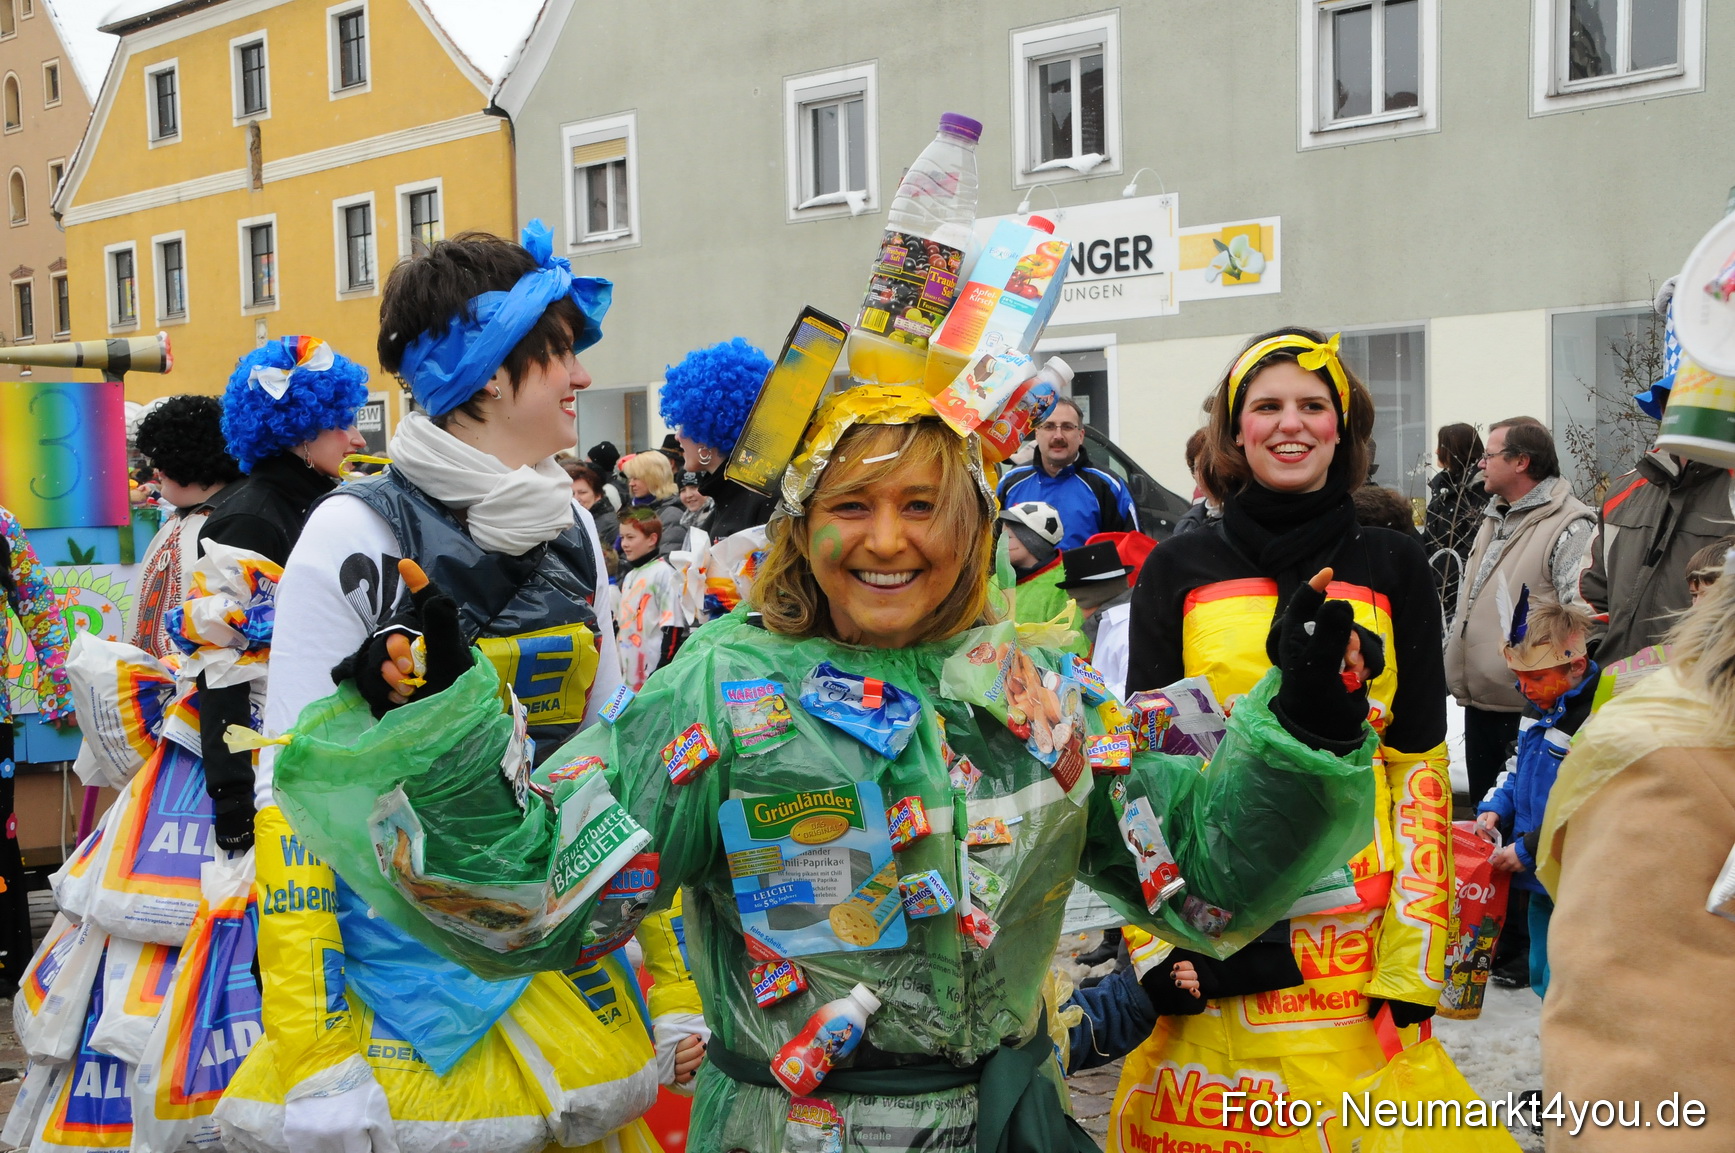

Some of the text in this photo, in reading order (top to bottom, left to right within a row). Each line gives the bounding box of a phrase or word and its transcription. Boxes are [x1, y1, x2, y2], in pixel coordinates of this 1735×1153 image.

[969, 294, 994, 307] Kirsch
[973, 287, 997, 299] Apfel-
[30, 388, 82, 500] 3
[608, 685, 628, 719] mentos
[727, 683, 775, 700] HARIBO
[1148, 710, 1157, 750] mentos
[665, 730, 700, 773] mentos
[686, 743, 703, 759] Kidz
[754, 789, 854, 823] Grünländer
[554, 814, 640, 893] BAGUETTE
[1402, 768, 1448, 930] Netto
[753, 884, 794, 901] LEICHT
[904, 887, 933, 909] mentos
[927, 875, 955, 905] mentos
[750, 925, 787, 955] feine Scheiben
[753, 961, 790, 996] mentos
[775, 974, 793, 986] Kidz
